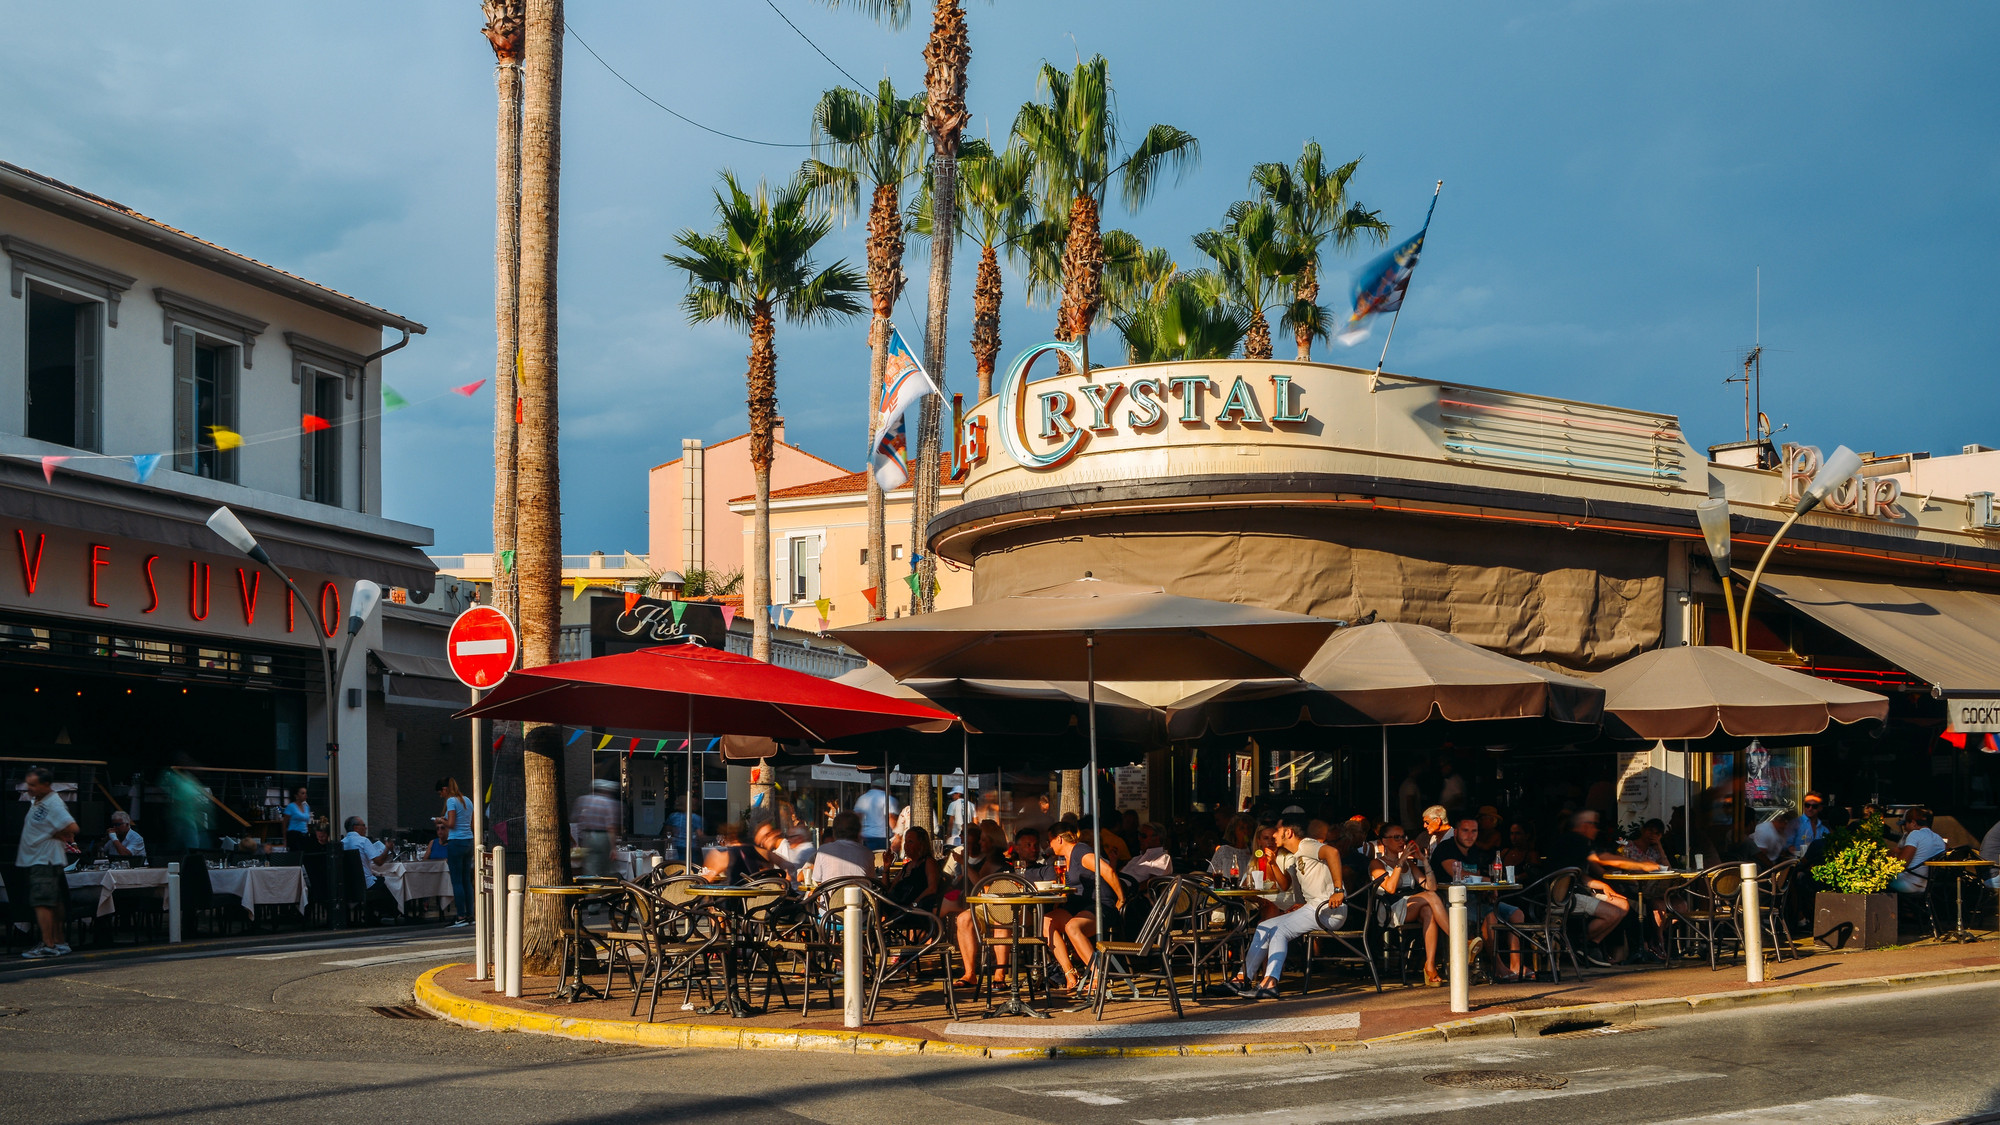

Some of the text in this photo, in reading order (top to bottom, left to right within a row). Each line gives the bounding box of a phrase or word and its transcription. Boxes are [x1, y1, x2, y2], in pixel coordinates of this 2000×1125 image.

[999, 336, 1309, 469] CRYSTAL
[16, 529, 340, 638] VESUVIO
[616, 604, 708, 644] Kiss
[1962, 707, 2000, 724] COCKT
